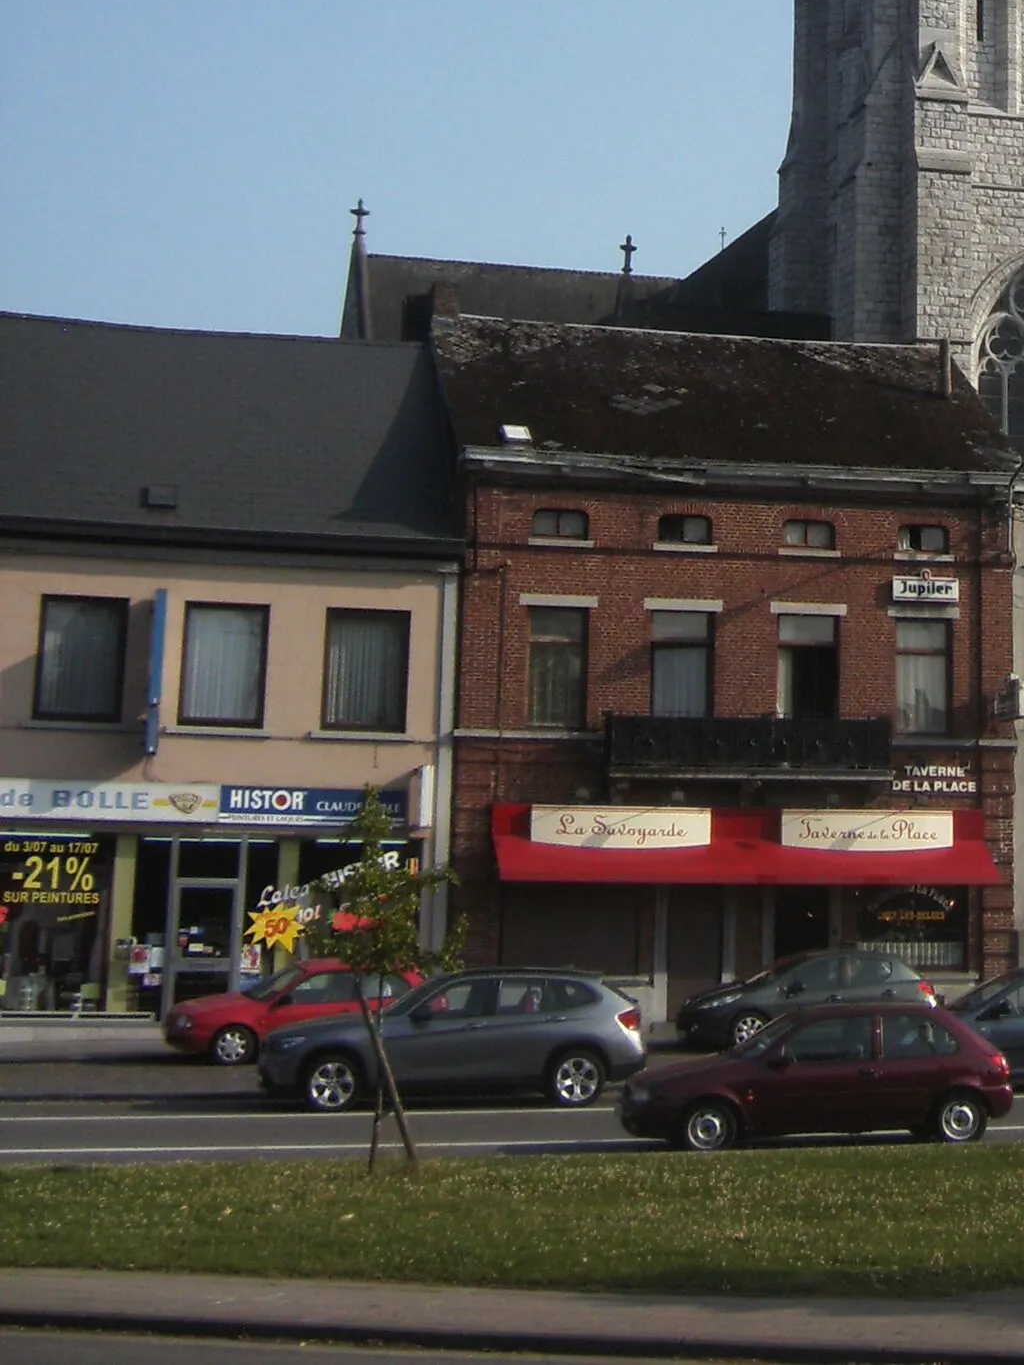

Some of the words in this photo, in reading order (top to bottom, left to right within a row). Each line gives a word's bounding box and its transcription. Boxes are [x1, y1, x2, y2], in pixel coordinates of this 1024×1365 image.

[900, 582, 953, 596] Jupiler
[904, 765, 965, 777] TAVERNE
[892, 781, 910, 791] DE
[913, 781, 931, 792] LA
[934, 781, 977, 792] PLACE
[52, 790, 149, 810] BOLLE
[230, 789, 304, 811] HISTOR
[556, 814, 586, 835] La
[591, 815, 688, 845] Savoyarde
[799, 818, 866, 841] Taverne
[867, 831, 878, 840] de
[880, 830, 890, 840] la
[892, 819, 938, 841] Place
[4, 841, 19, 852] du
[23, 841, 47, 852] 3/07
[50, 844, 64, 853] au
[68, 843, 98, 854] 17/07
[12, 856, 94, 891] -21%
[4, 891, 29, 903] SUR
[31, 893, 99, 904] PEINTURES
